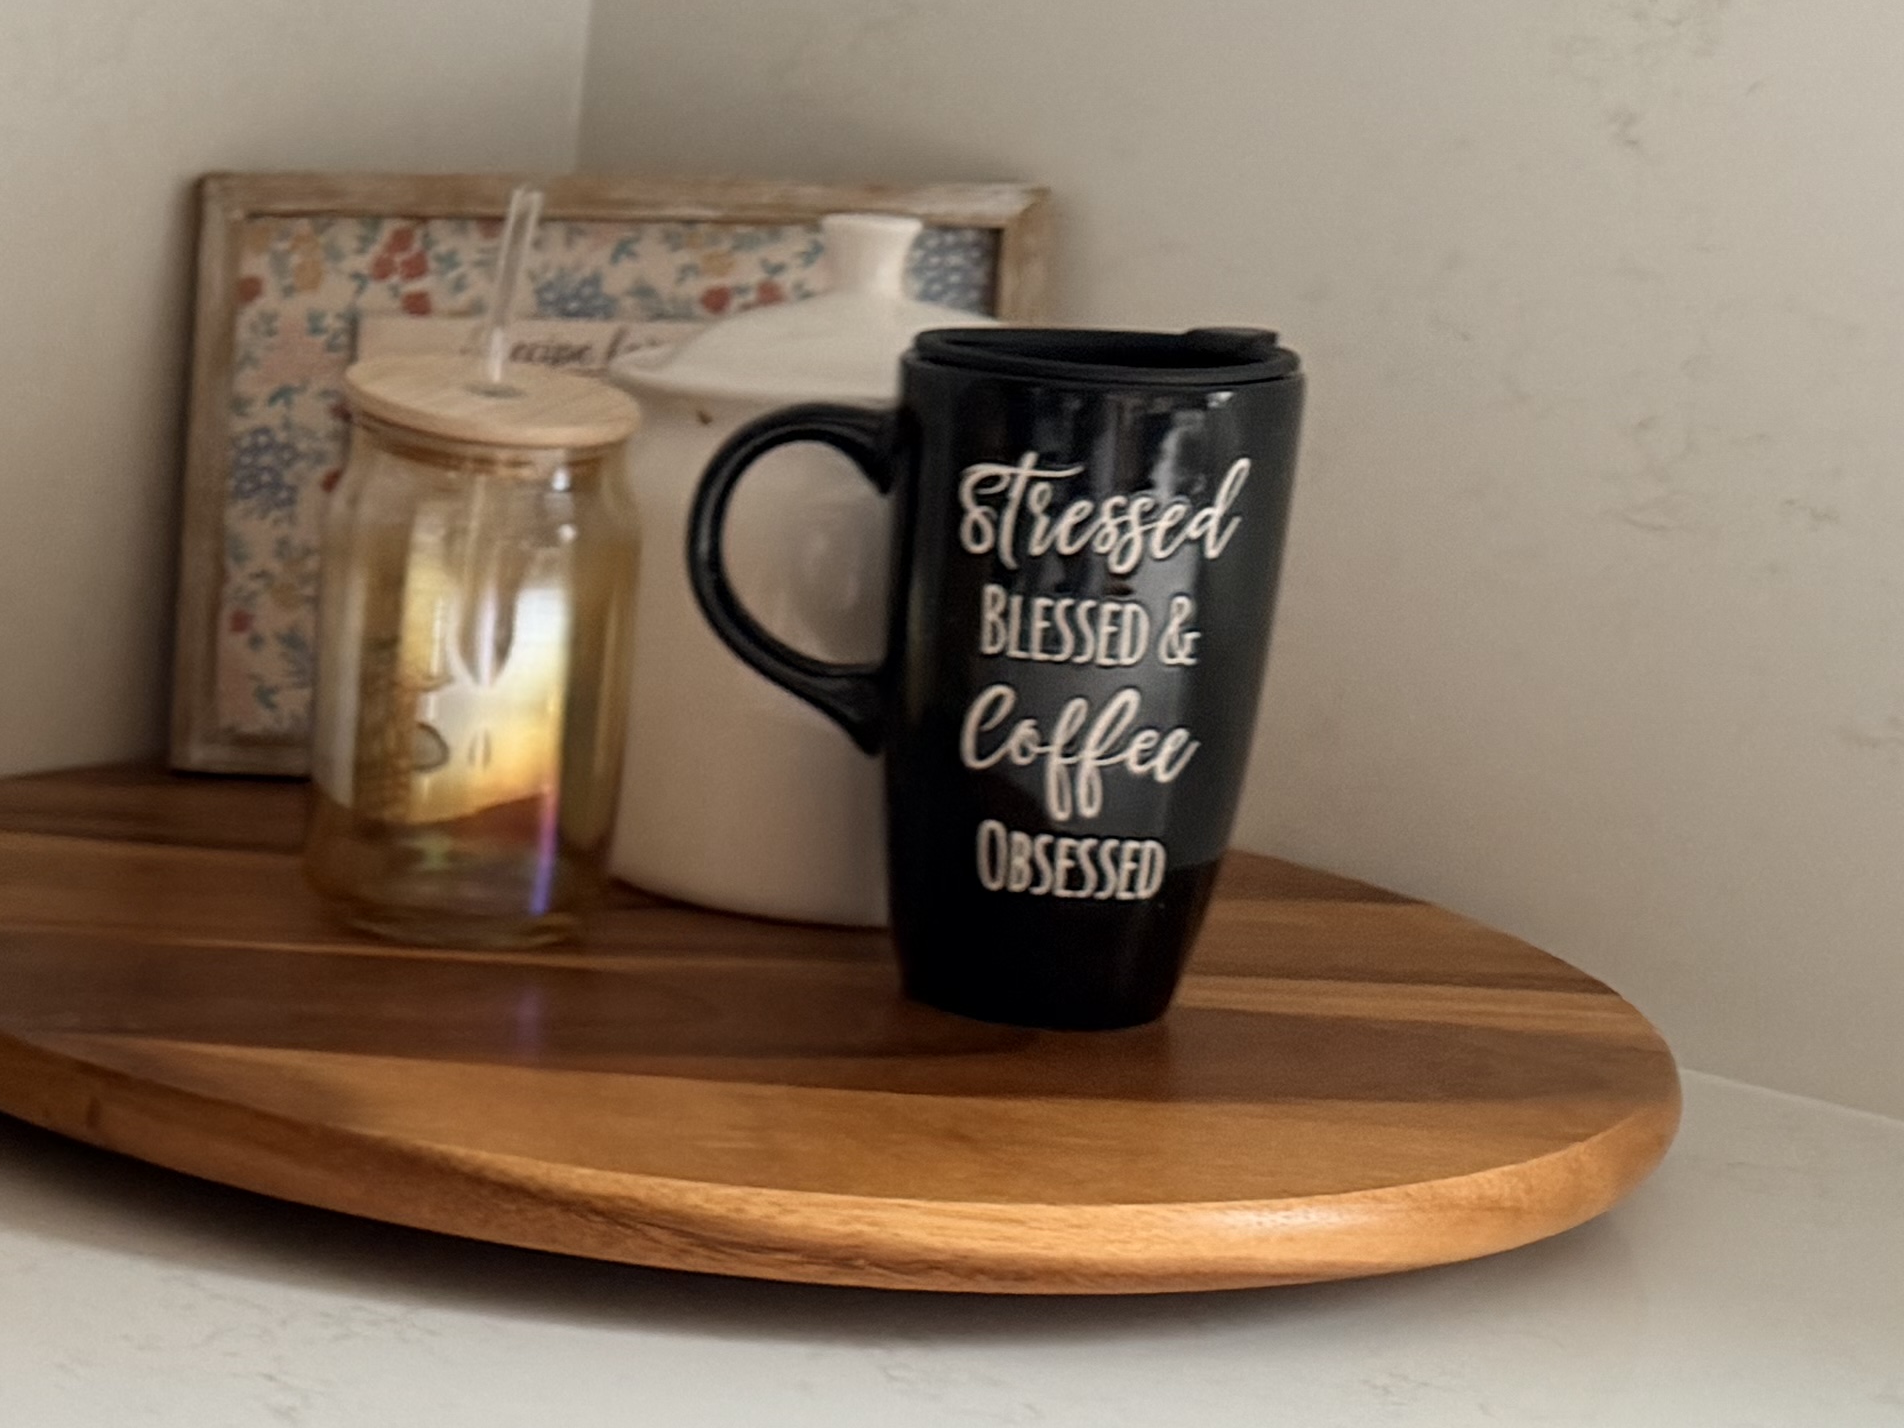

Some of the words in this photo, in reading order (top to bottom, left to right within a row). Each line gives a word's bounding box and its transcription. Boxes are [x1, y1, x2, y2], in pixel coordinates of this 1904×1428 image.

[959, 452, 1250, 573] Stressed
[980, 584, 1149, 666] BLESSED
[1159, 596, 1199, 666] &
[961, 685, 1199, 820] Coffee
[977, 819, 1166, 901] OBSESSED
